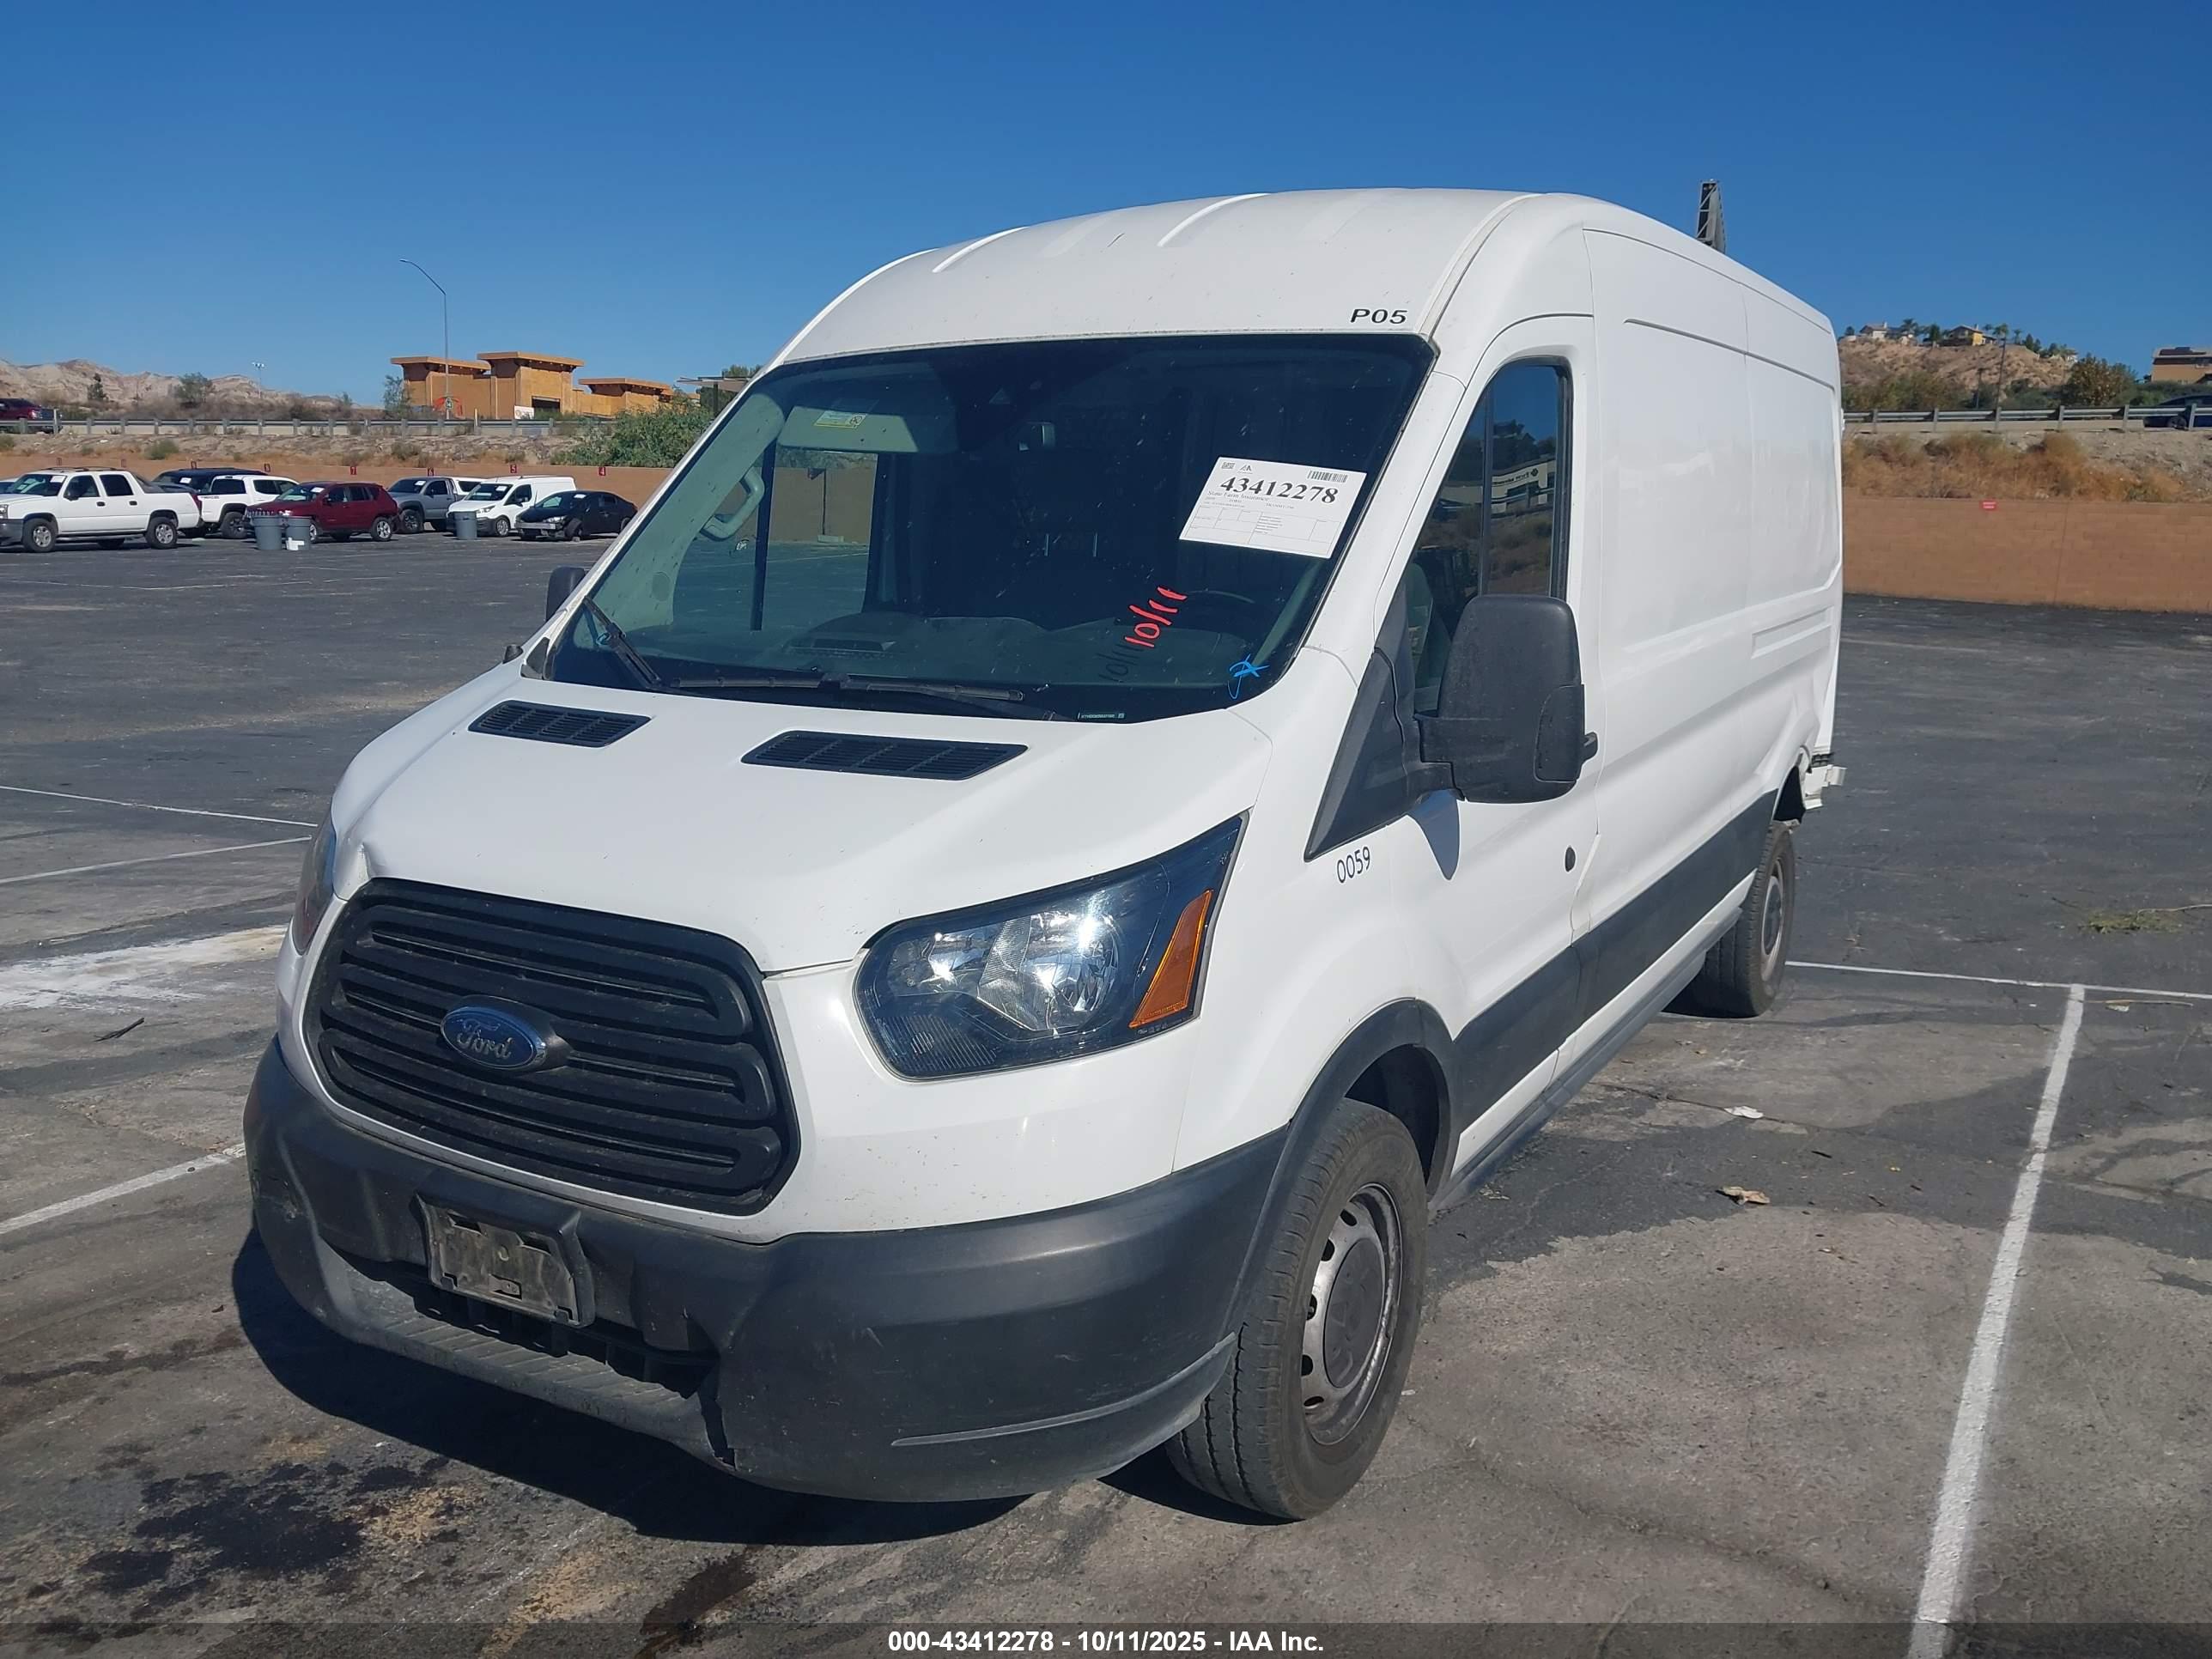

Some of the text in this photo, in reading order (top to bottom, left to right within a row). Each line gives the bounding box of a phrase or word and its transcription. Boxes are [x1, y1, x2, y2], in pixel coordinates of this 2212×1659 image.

[1350, 308, 1408, 325] P05
[1220, 476, 1340, 505] 43412278
[1336, 846, 1370, 884] 0059
[456, 1018, 514, 1059] Ford
